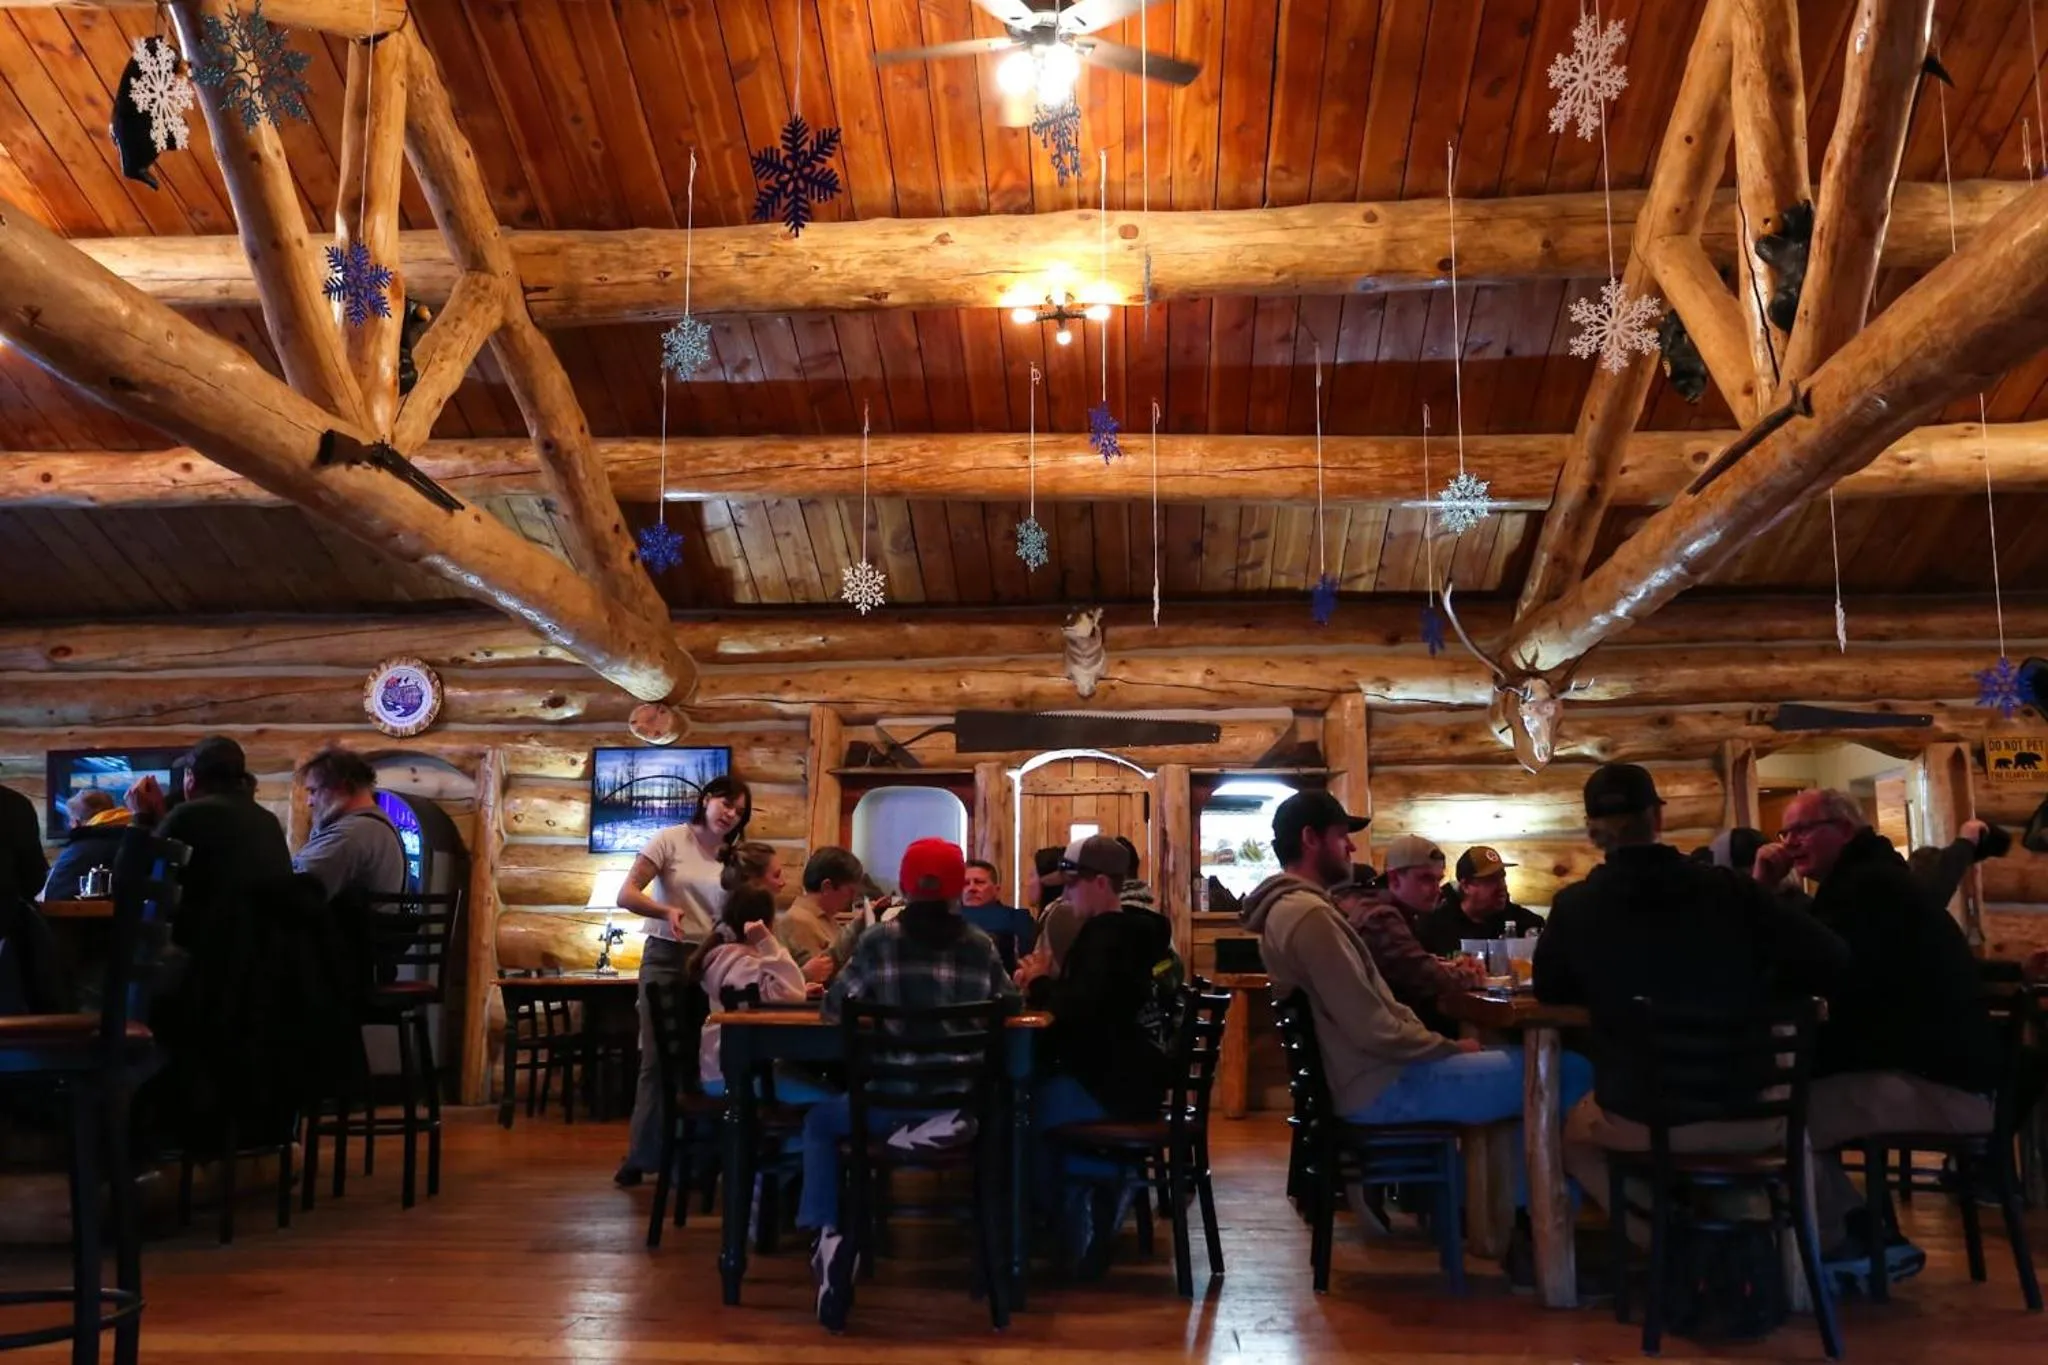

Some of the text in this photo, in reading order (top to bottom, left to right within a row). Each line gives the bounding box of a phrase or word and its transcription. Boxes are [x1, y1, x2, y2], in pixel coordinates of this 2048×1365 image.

[1989, 740, 2044, 751] DO NOT PET
